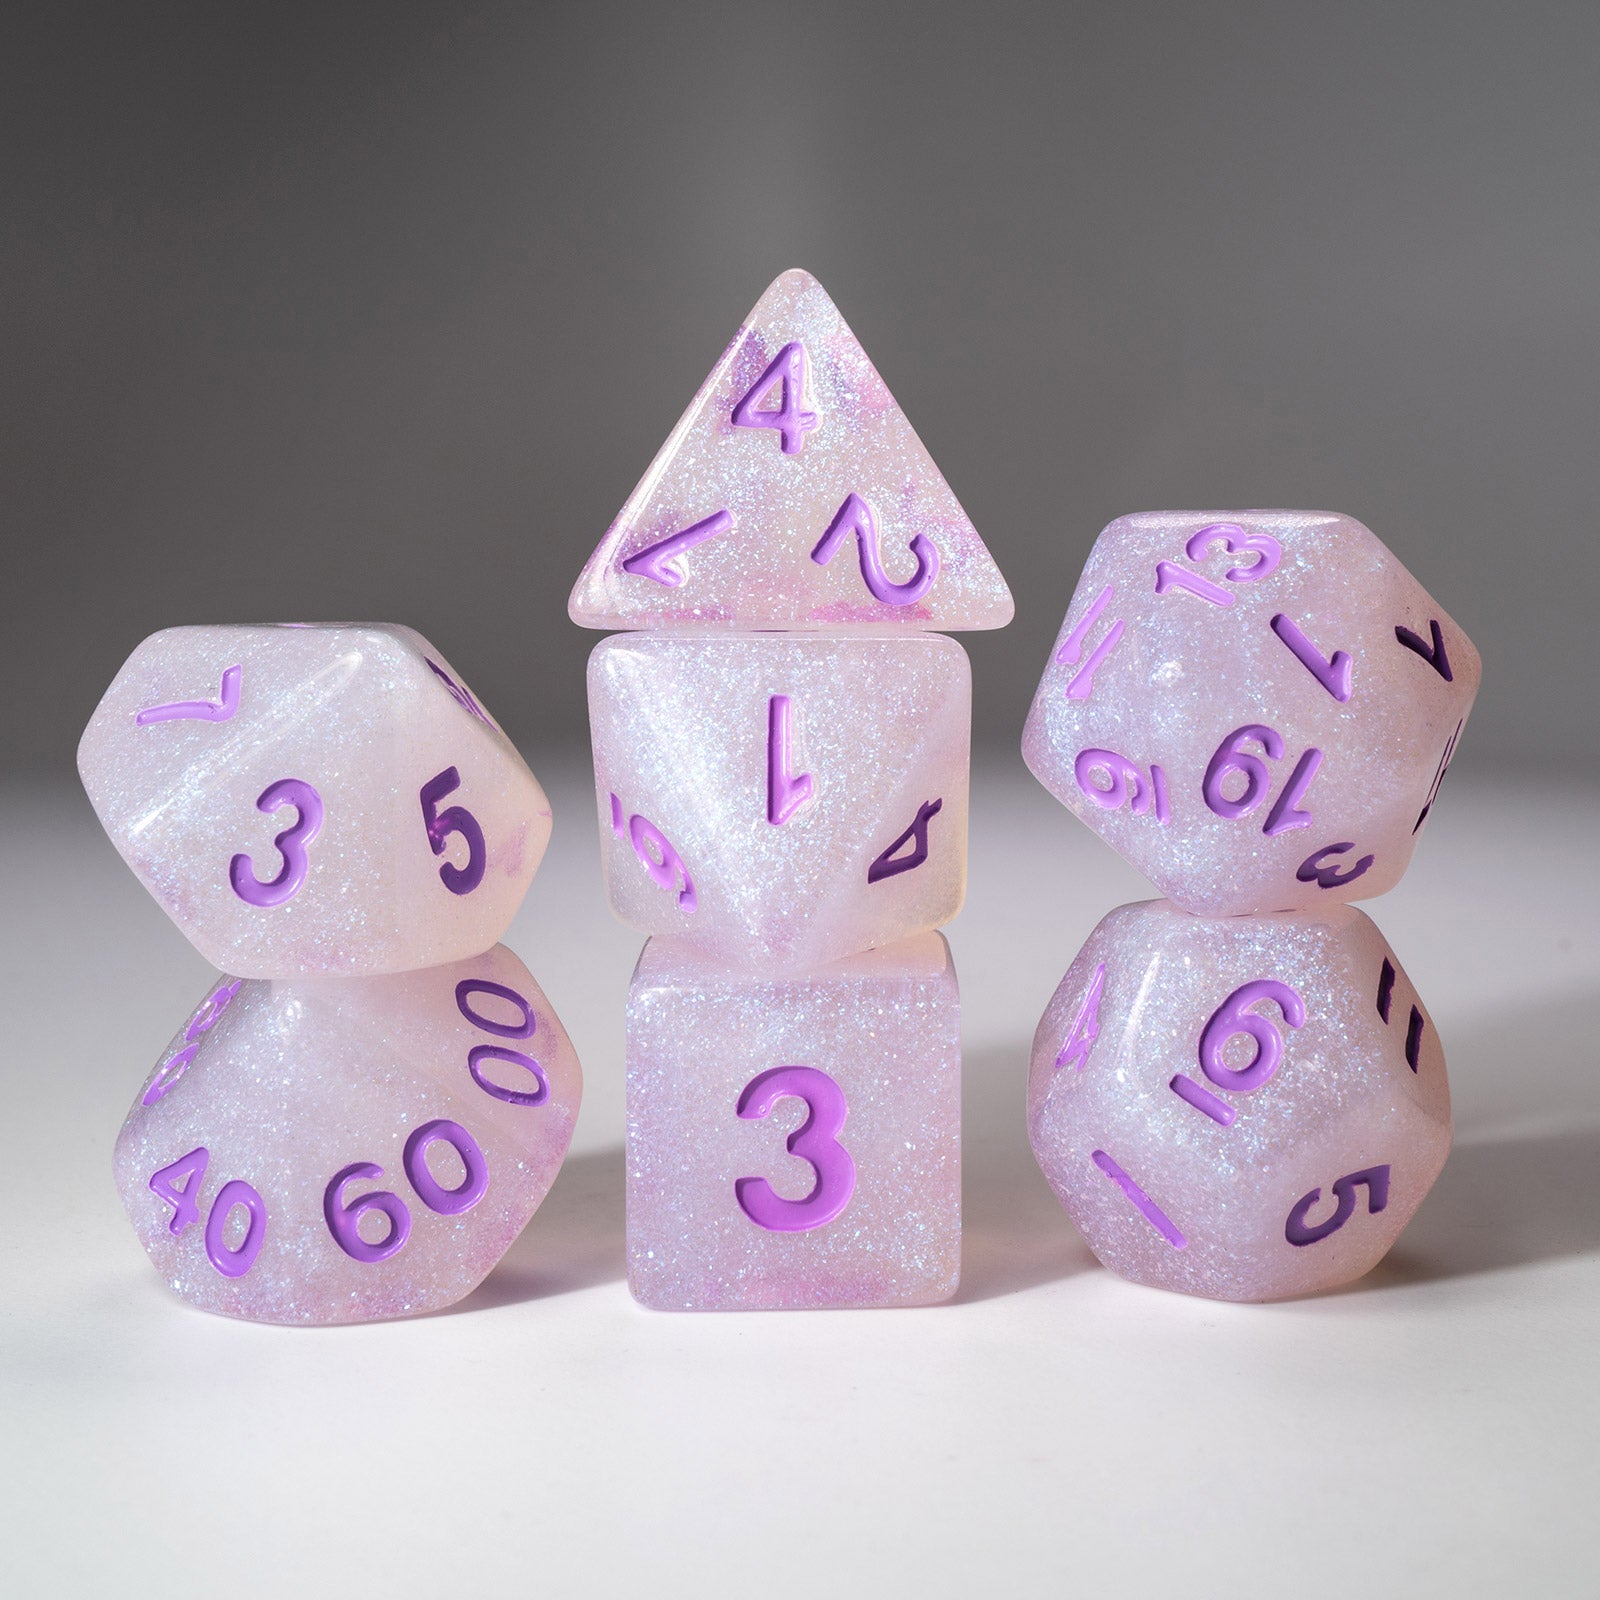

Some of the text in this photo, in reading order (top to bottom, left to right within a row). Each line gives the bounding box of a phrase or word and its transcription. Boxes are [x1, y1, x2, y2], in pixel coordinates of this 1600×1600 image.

[731, 341, 818, 455] 4
[811, 491, 940, 606] 2
[1154, 523, 1282, 608] 13
[135, 663, 242, 727] 7
[1055, 584, 1125, 700] 11
[1270, 613, 1353, 703] 1
[766, 694, 813, 826] 1
[1202, 723, 1324, 837] 19
[229, 778, 325, 908] 3
[419, 765, 487, 896] 5
[867, 797, 943, 885] 4
[1296, 841, 1376, 890] 3
[455, 978, 551, 1108] 00
[322, 1119, 490, 1264] 60
[735, 1065, 857, 1234] 3
[1284, 1164, 1392, 1248] 5
[149, 1146, 268, 1280] 40
